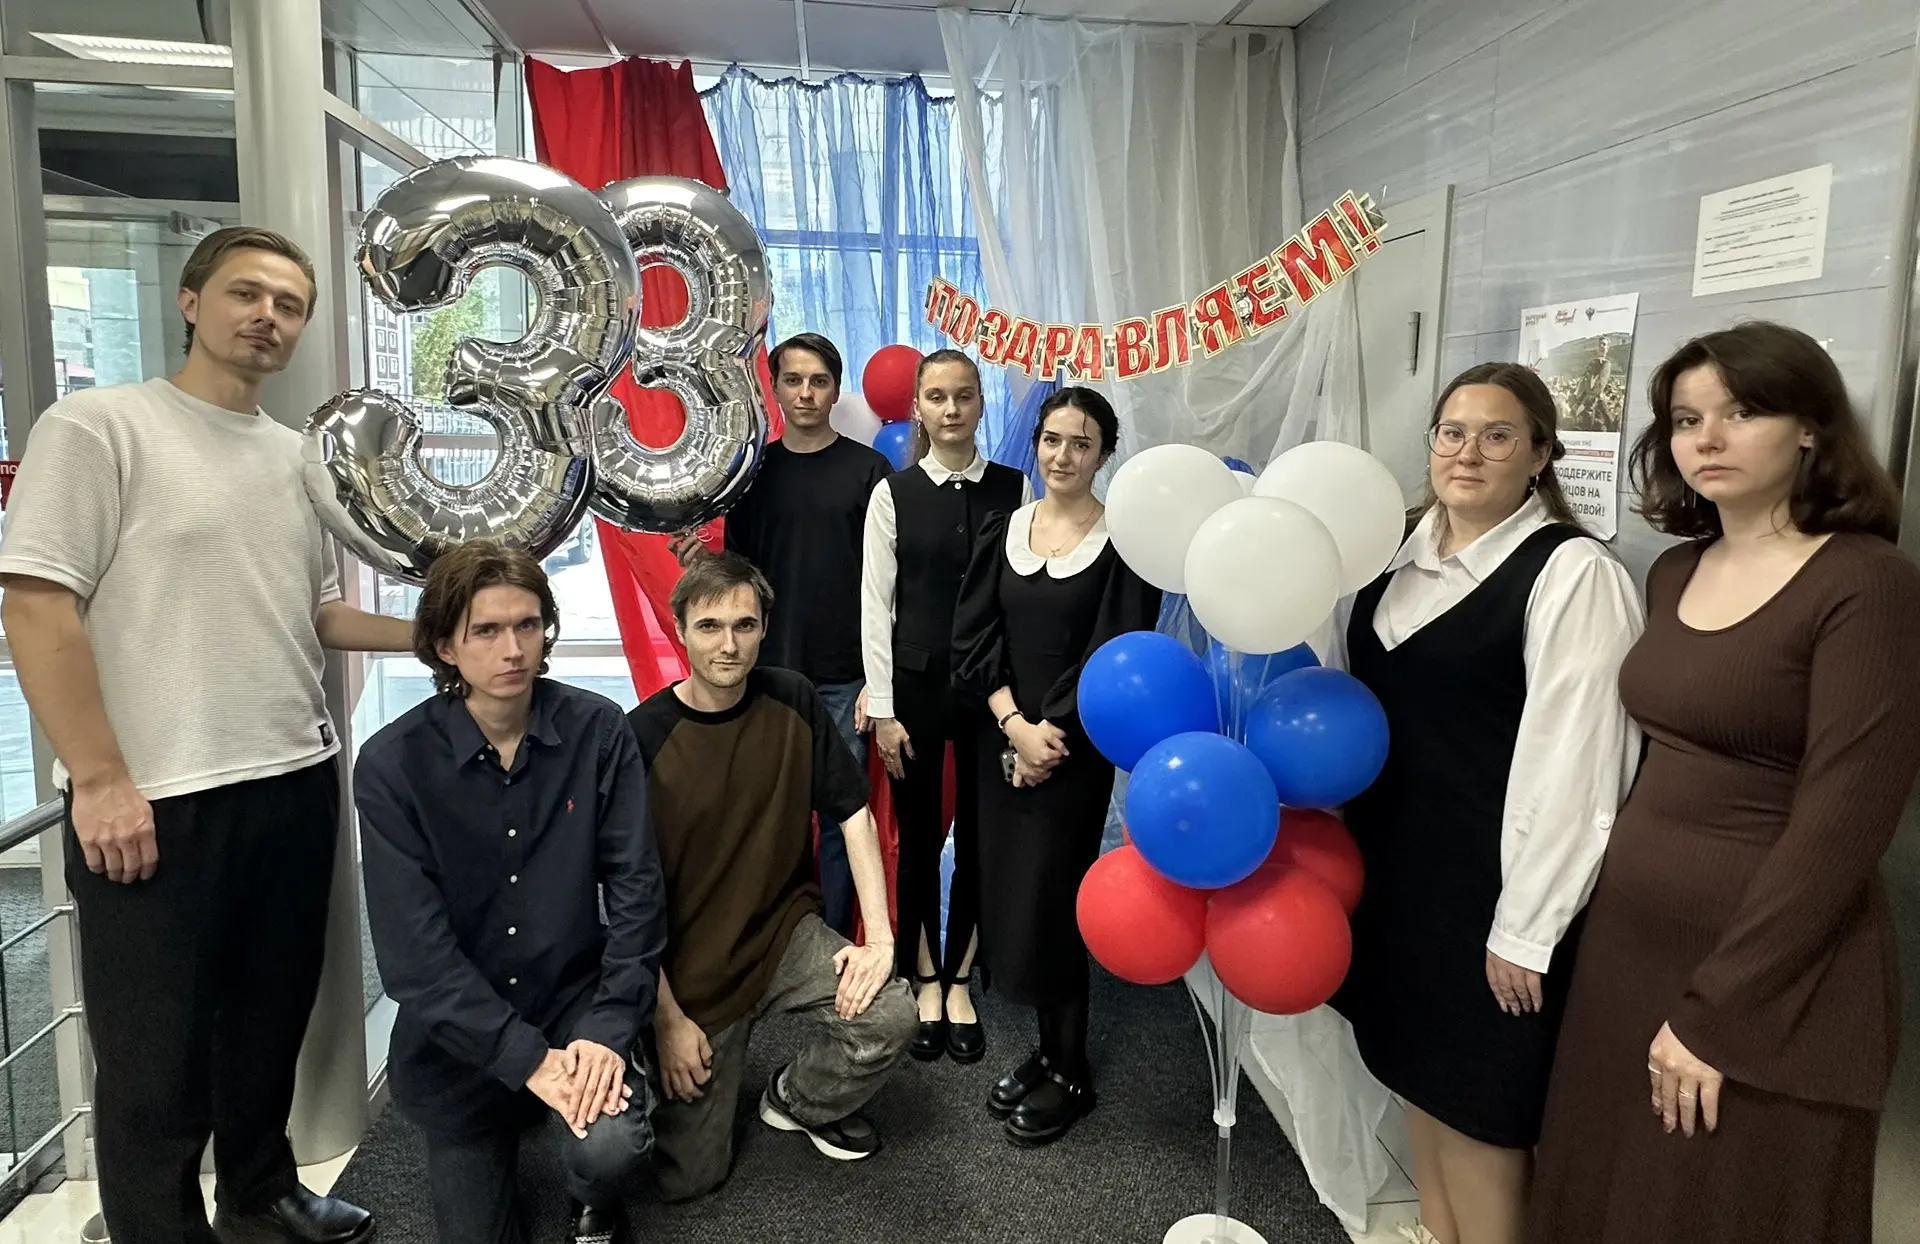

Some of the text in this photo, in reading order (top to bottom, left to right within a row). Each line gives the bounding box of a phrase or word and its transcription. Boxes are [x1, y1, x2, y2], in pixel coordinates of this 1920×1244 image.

[925, 188, 1383, 382] ПОЗДРАВЛЯЕМ!
[1562, 482, 1600, 498] ЙЦОВ НА
[1568, 502, 1605, 517] ДОВОЙ!
